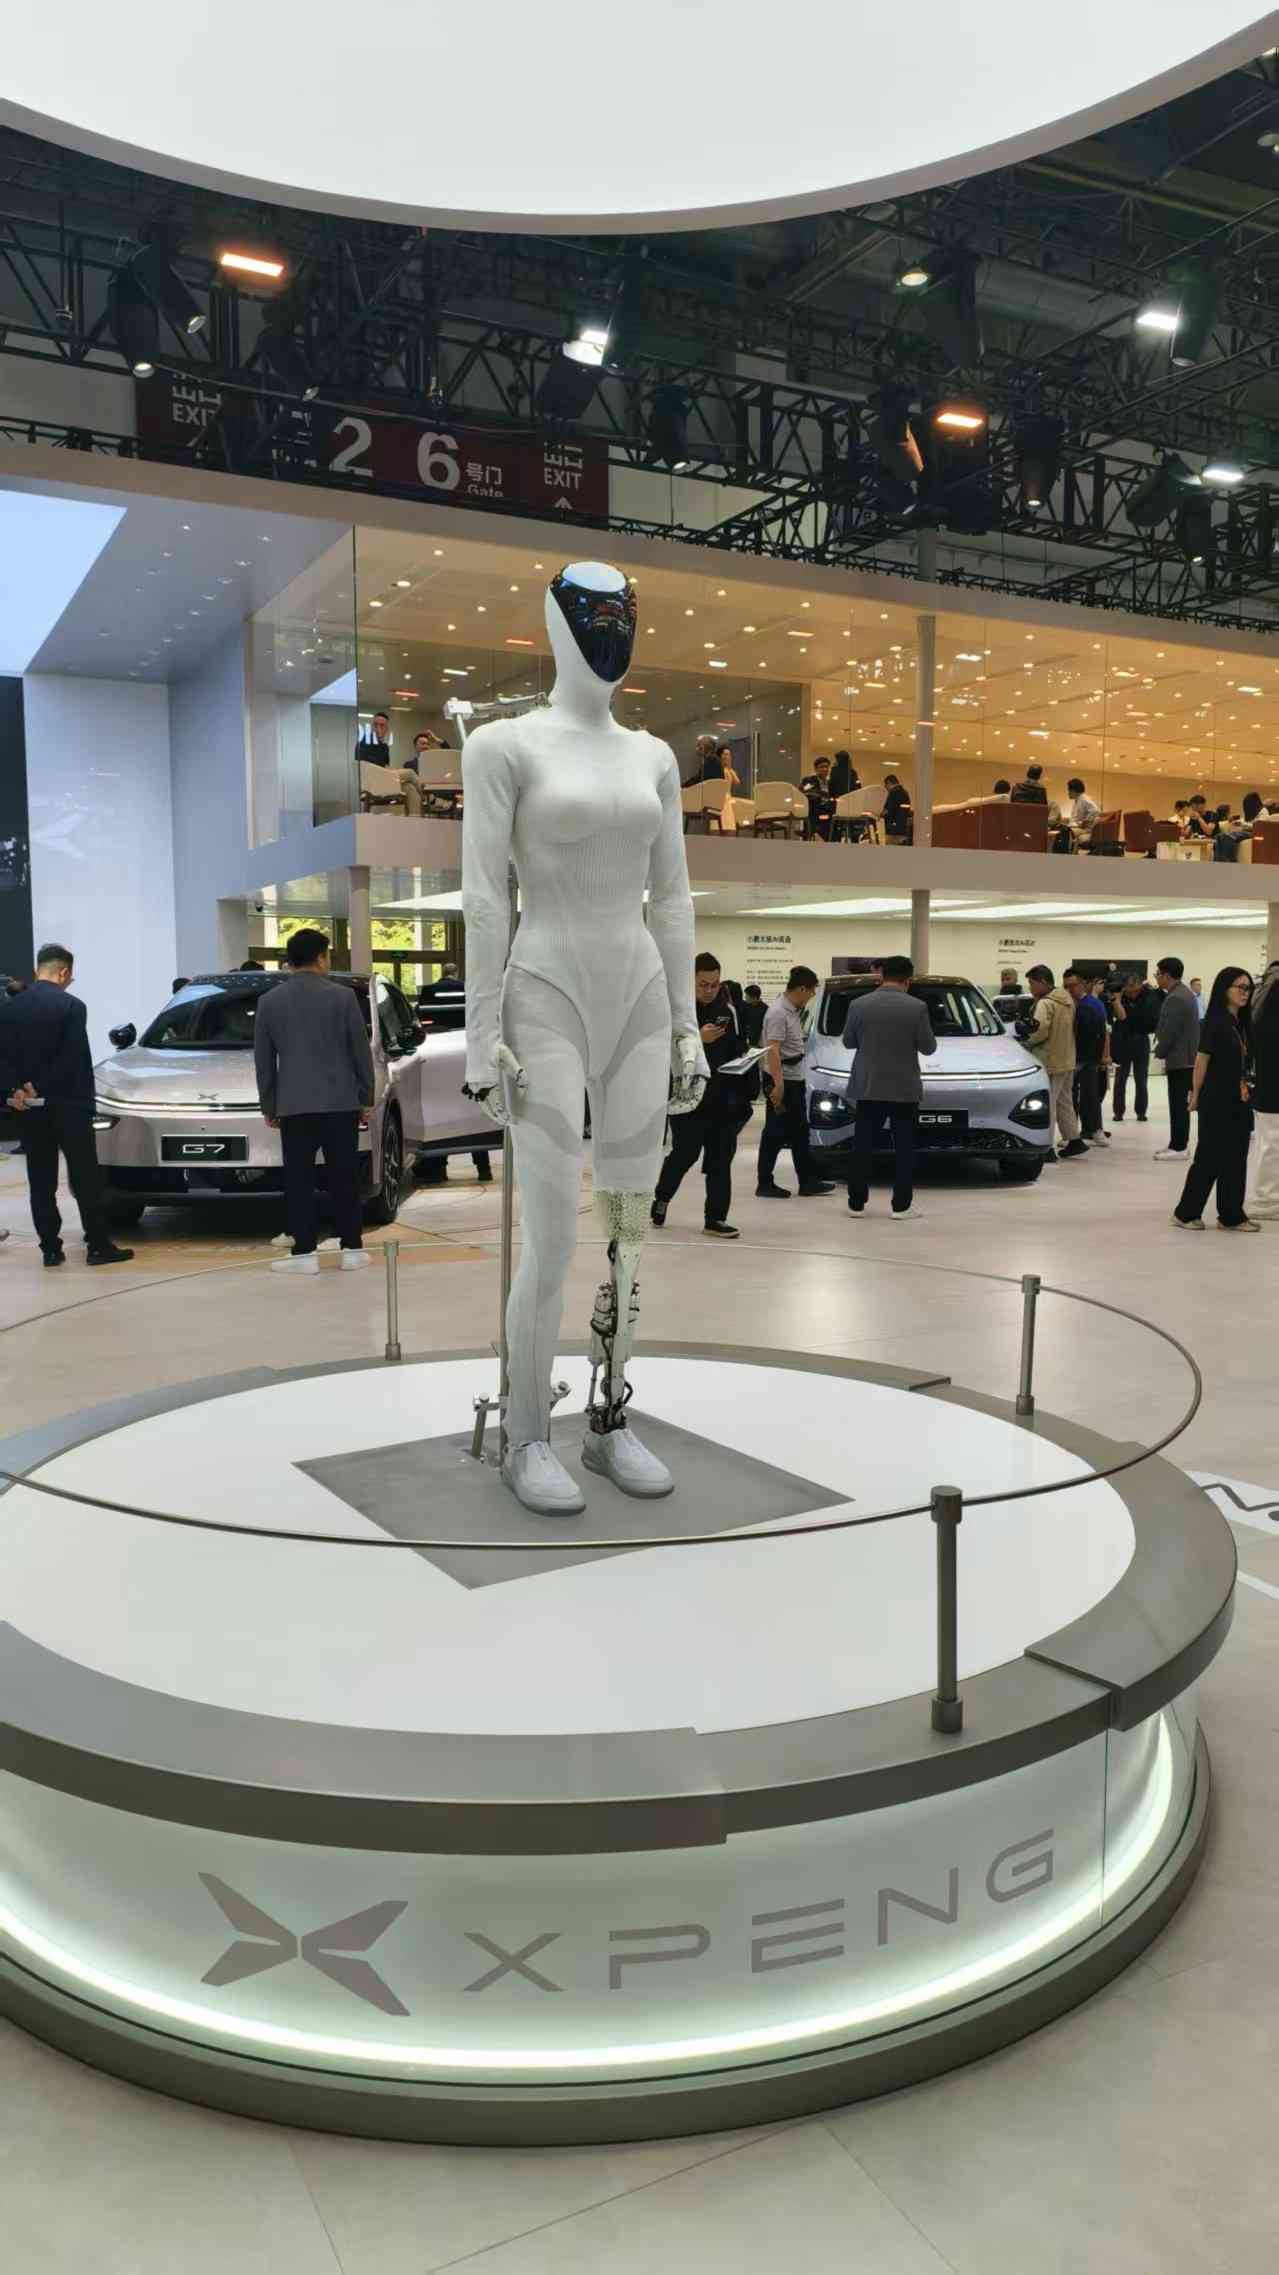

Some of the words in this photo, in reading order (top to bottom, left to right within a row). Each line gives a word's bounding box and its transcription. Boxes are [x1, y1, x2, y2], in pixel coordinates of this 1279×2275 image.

[417, 431, 461, 490] 6
[465, 462, 502, 485] 号门
[544, 468, 582, 489] EXIT
[919, 1114, 953, 1123] G6
[182, 1143, 225, 1154] G7
[463, 1827, 1054, 1992] XPENG
